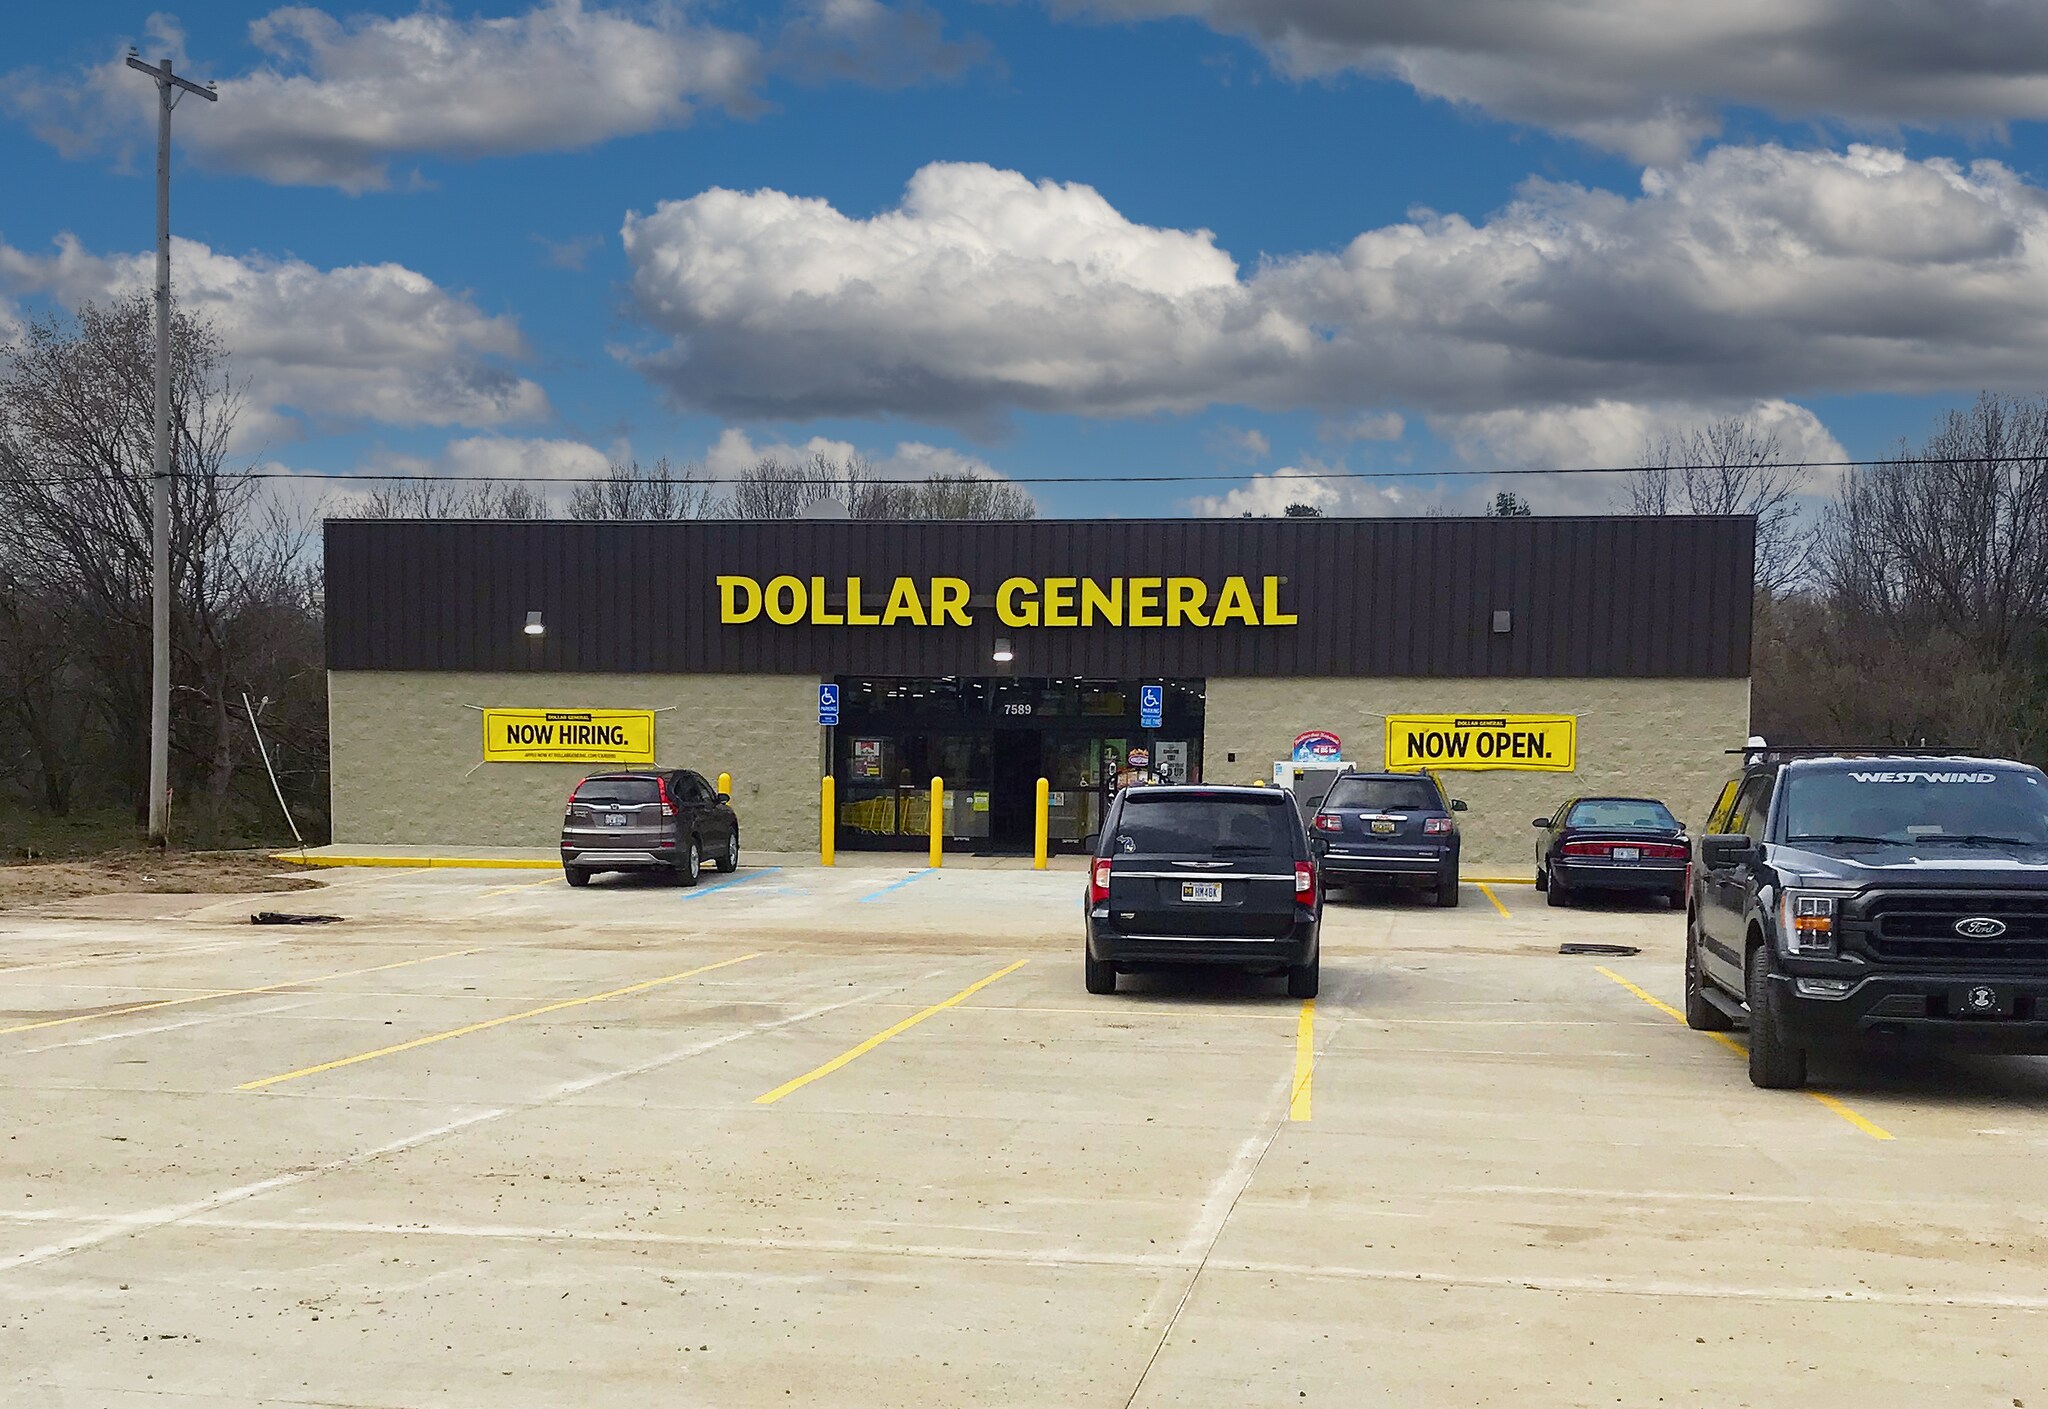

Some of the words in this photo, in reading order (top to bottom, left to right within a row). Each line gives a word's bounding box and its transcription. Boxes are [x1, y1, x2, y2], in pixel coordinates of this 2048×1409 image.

[716, 575, 972, 627] DOLLAR
[996, 576, 1298, 627] GENERAL
[1004, 704, 1032, 715] 7589
[507, 724, 554, 745] NOW
[559, 725, 629, 746] HIRING.
[1408, 732, 1470, 758] NOW
[1476, 732, 1552, 759] OPEN.
[1848, 772, 1997, 784] WESTWIND
[1967, 921, 1995, 933] Ford
